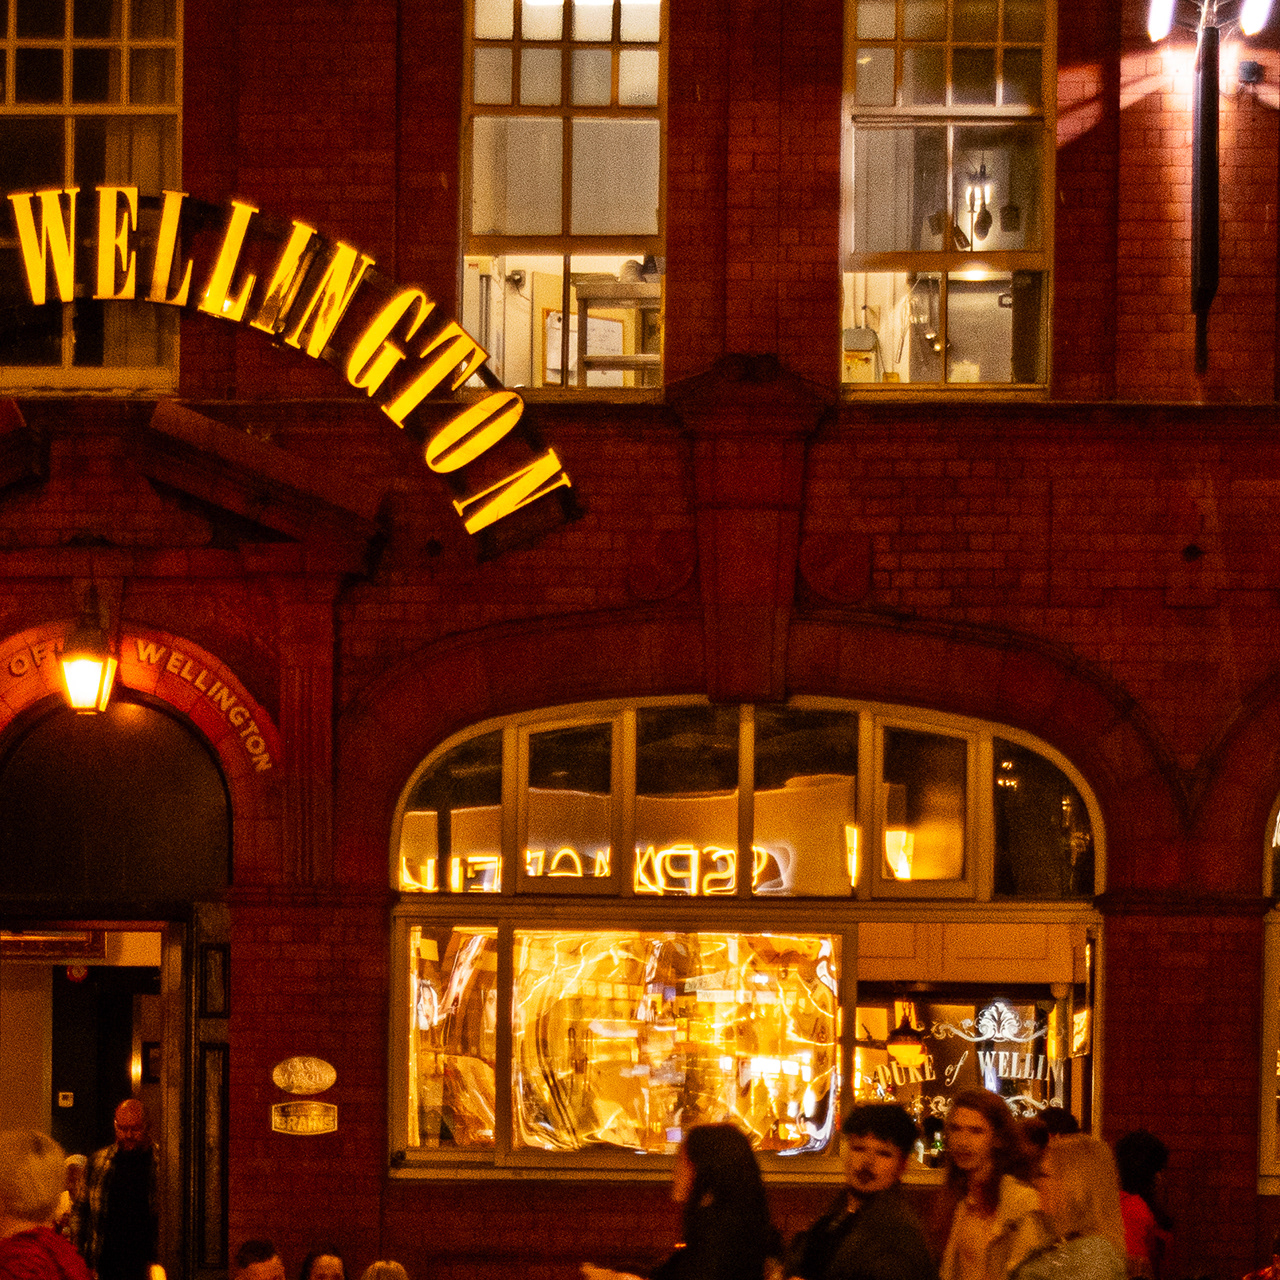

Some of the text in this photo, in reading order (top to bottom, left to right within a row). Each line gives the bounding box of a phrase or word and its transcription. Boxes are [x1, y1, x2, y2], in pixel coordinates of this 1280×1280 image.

[6, 185, 573, 536] WELLINGTON
[7, 643, 50, 678] OF
[135, 638, 273, 773] WELLINGTON
[875, 1054, 937, 1089] DUKE
[944, 1050, 970, 1087] of
